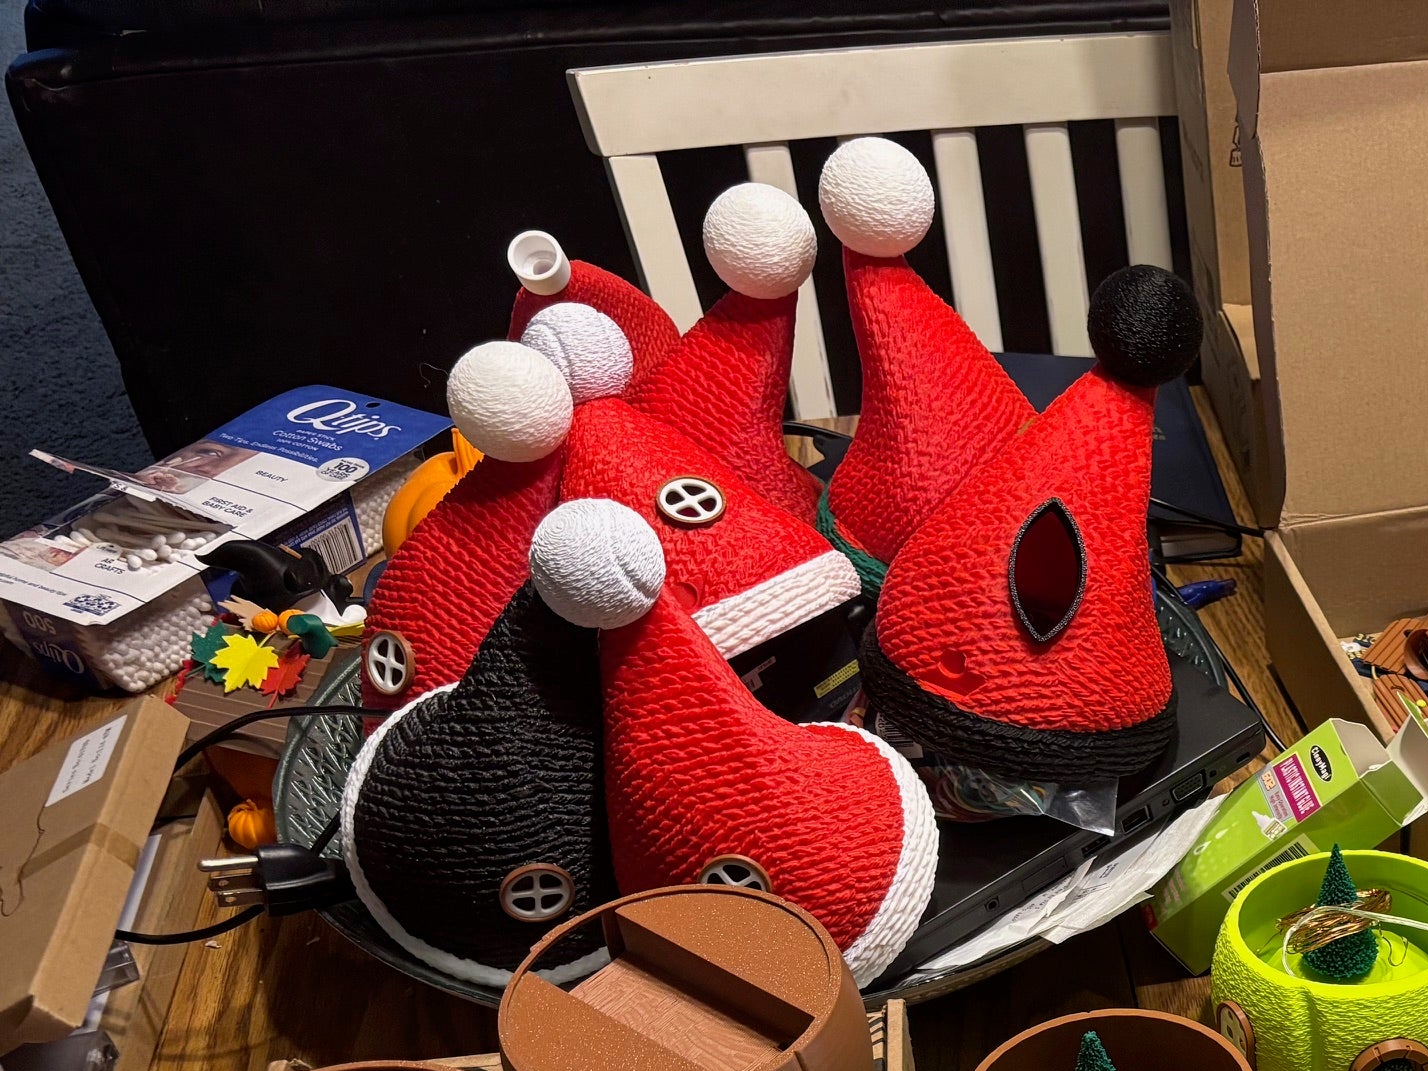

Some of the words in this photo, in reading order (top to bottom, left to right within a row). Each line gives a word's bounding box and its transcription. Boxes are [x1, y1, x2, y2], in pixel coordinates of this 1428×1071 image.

[273, 430, 304, 443] Cotton
[307, 436, 343, 451] Swabs
[333, 462, 356, 474] 100
[256, 470, 288, 483] BEAUTY
[201, 500, 225, 513] BABY
[226, 506, 247, 518] CARE
[209, 496, 232, 508] FIRST
[231, 502, 246, 512] AID
[94, 563, 126, 575] CRAFTS
